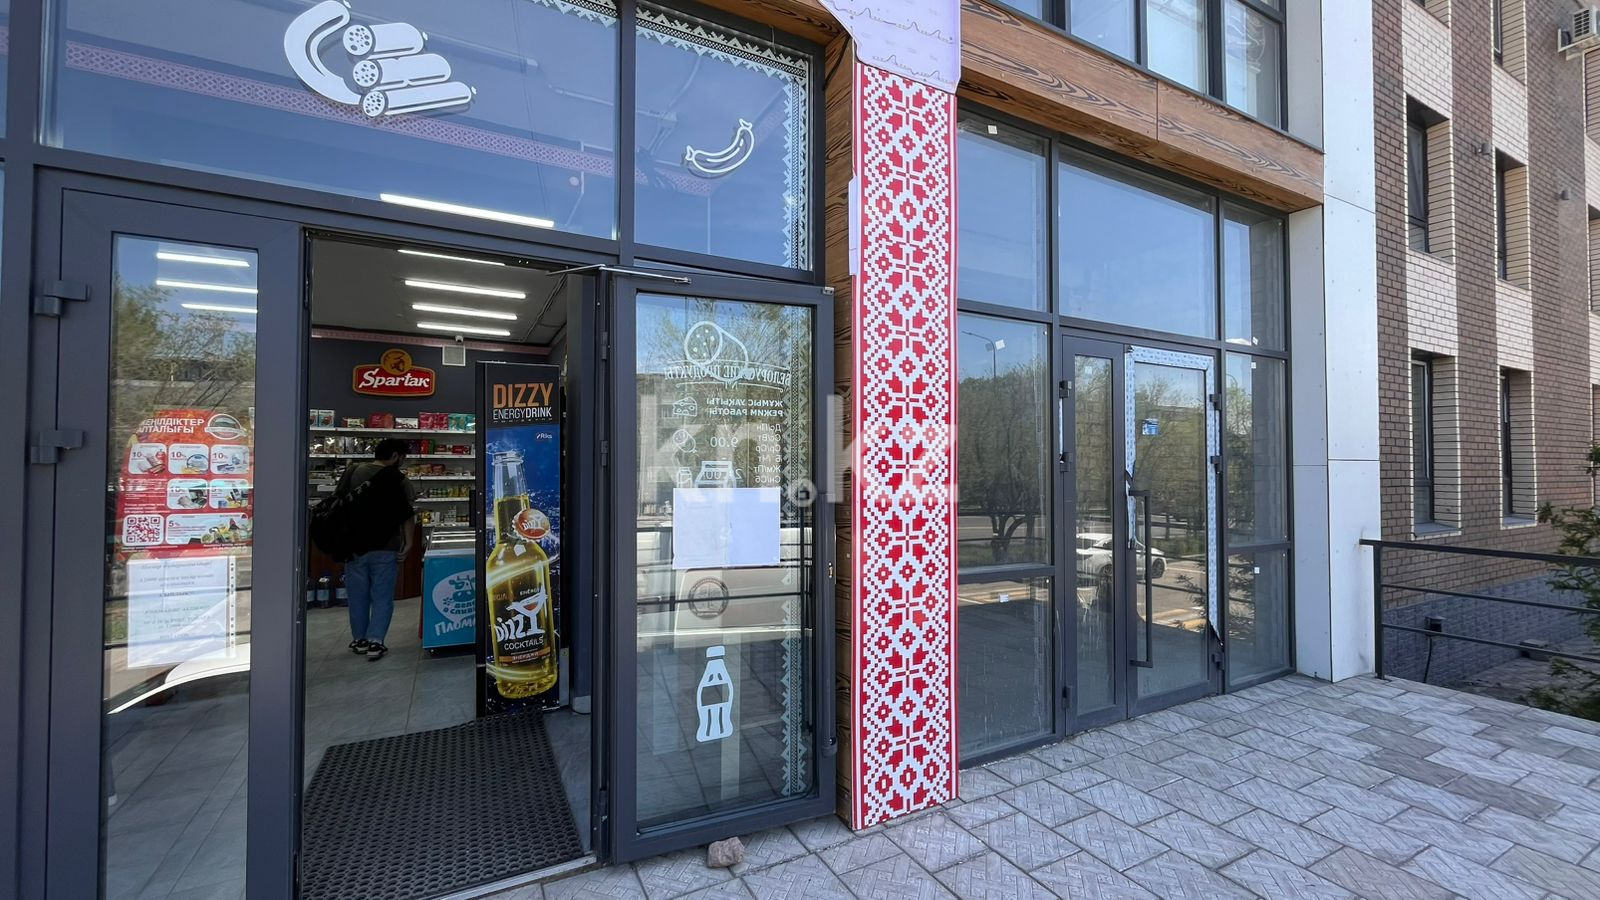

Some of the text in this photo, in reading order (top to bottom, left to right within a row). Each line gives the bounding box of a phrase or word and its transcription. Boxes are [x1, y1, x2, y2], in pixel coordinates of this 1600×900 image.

[358, 367, 430, 389] Spartak
[492, 382, 554, 408] DIZZY
[503, 635, 544, 651] COCKTAILS
